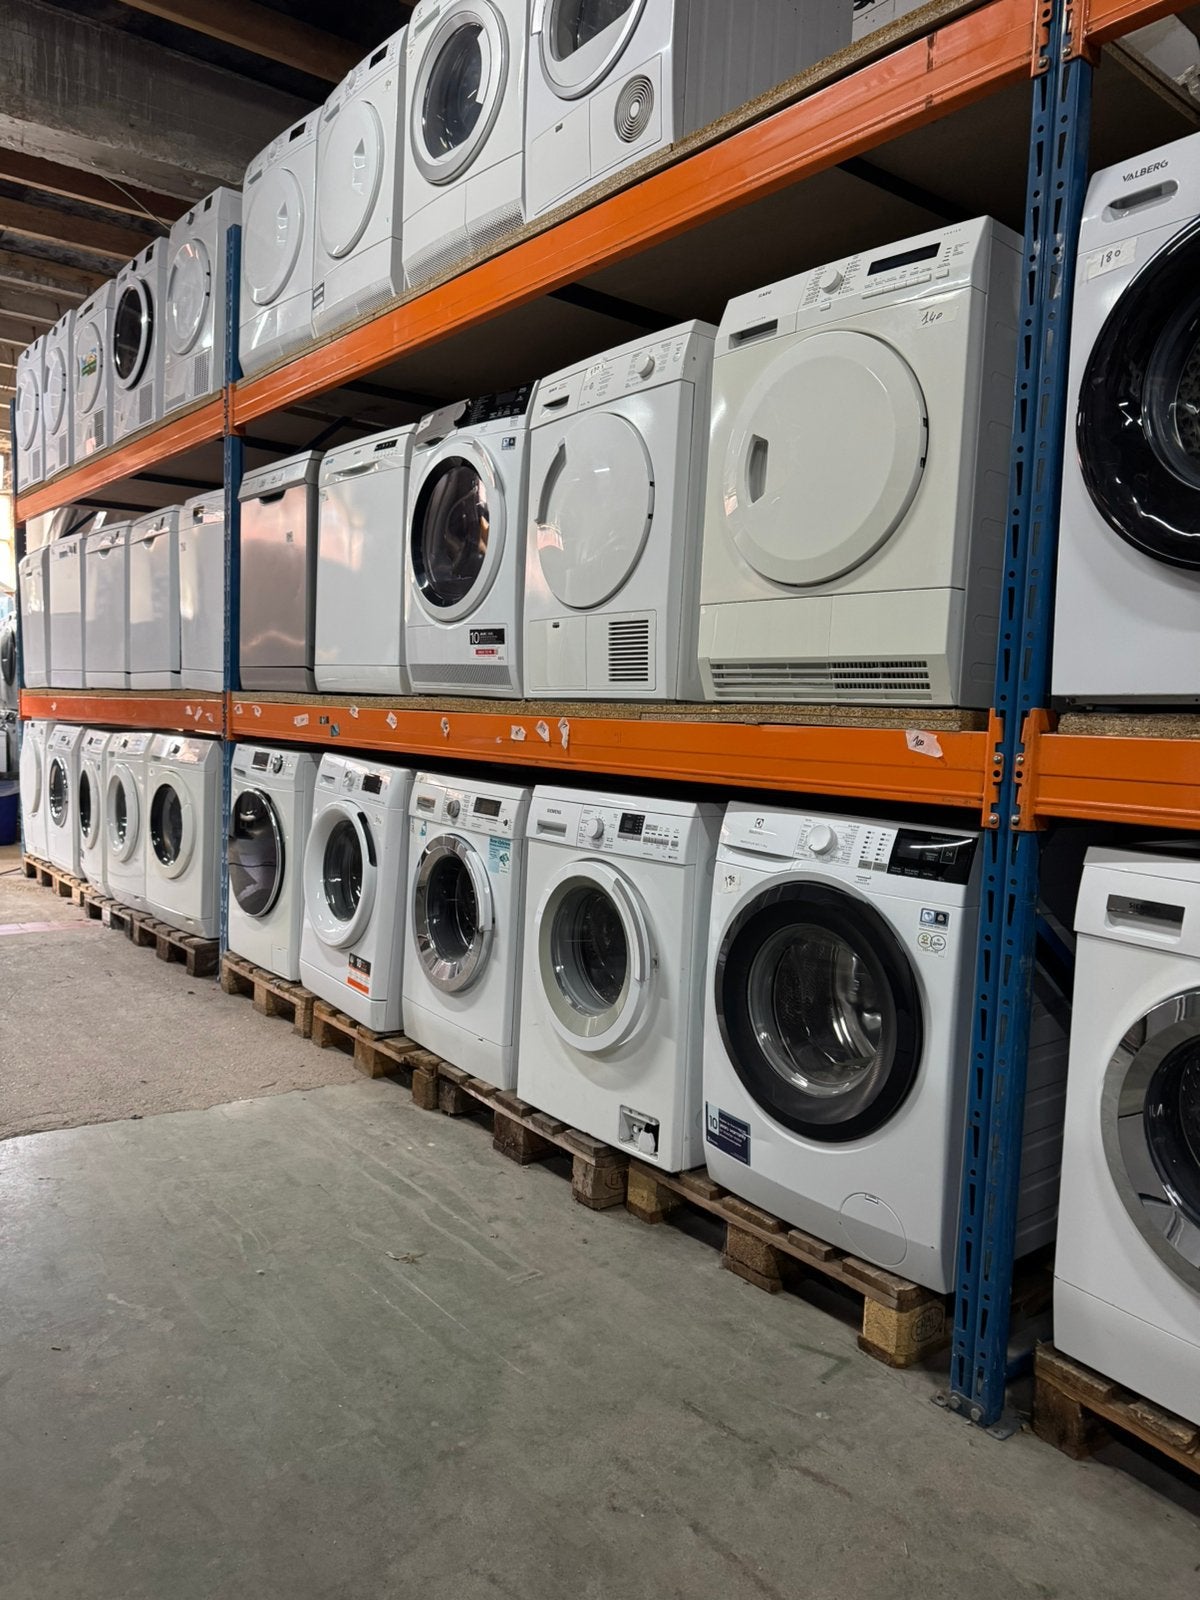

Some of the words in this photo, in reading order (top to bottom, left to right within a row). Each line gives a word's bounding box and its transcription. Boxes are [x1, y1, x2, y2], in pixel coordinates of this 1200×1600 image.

[1122, 160, 1169, 182] VALBERG
[1100, 250, 1121, 267] 180
[921, 311, 943, 326] 140
